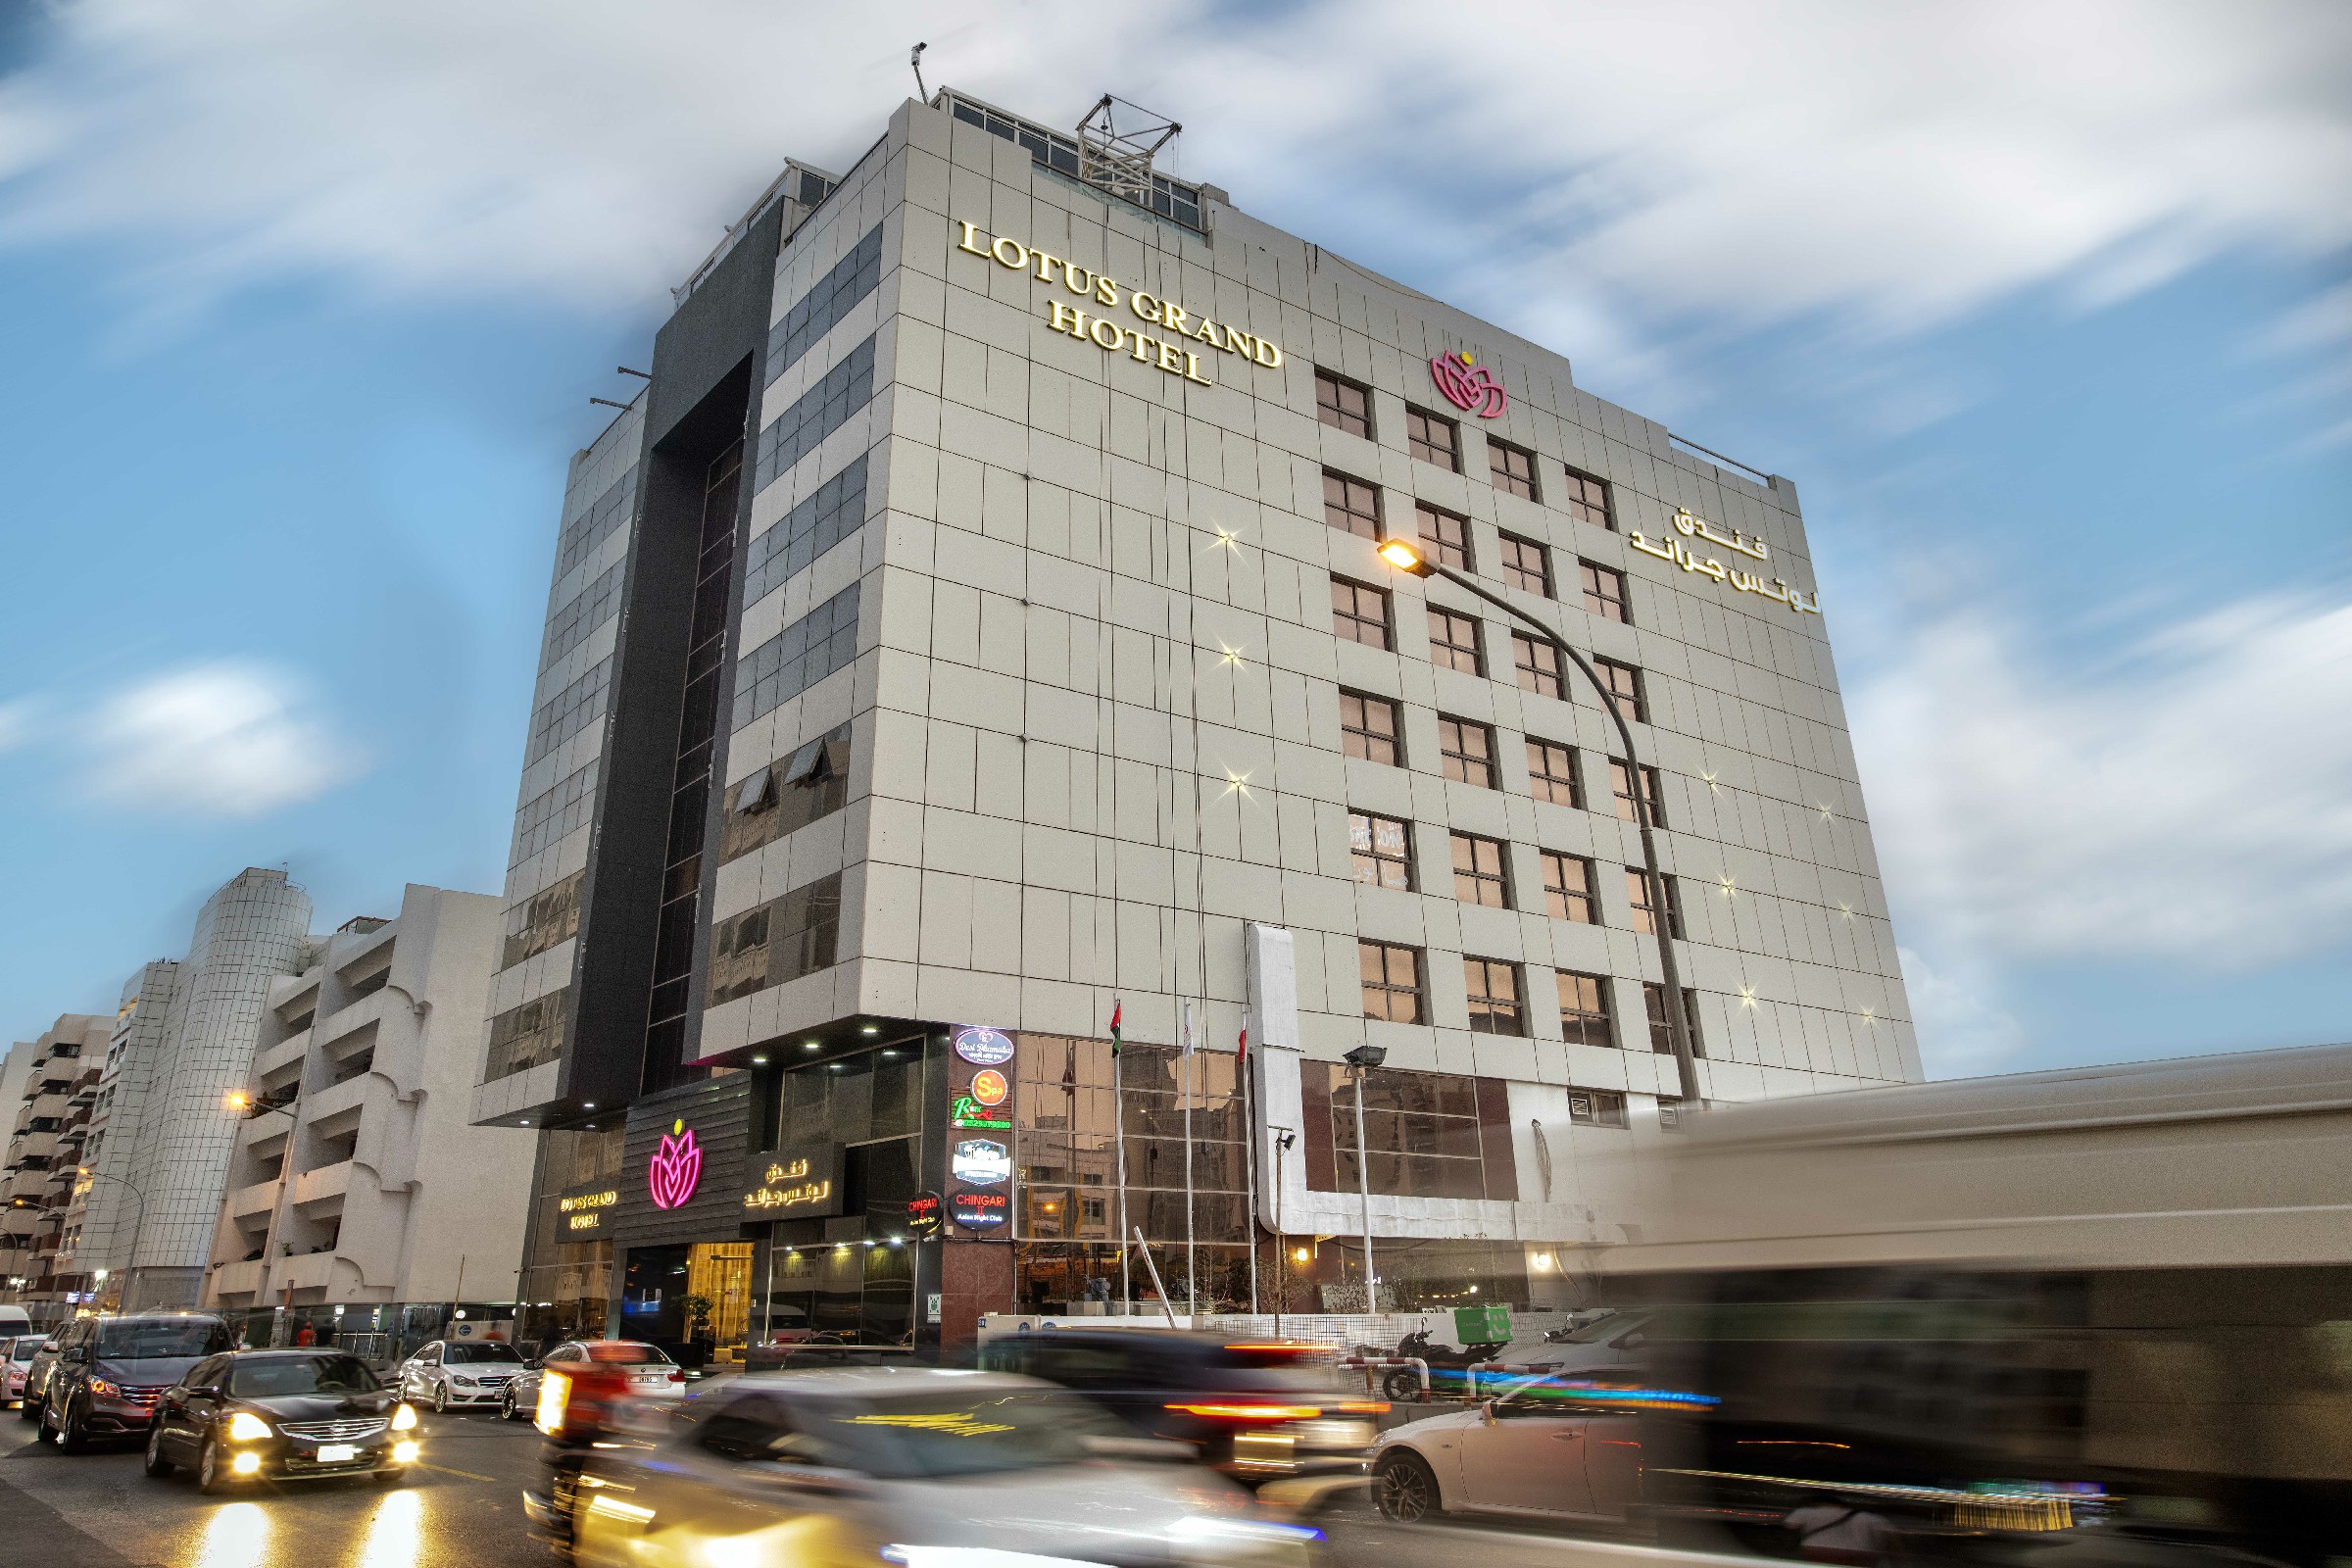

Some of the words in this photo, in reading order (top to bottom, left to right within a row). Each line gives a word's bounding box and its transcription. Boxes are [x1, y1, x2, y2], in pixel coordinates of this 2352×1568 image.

[957, 220, 1118, 307] LOTUS
[1130, 291, 1284, 368] GRAND
[1048, 299, 1212, 386] HOTEL
[1630, 530, 1726, 583] جراند
[1672, 507, 1768, 561] فندق
[1729, 568, 1822, 613] لوتس
[976, 1076, 1004, 1097] Spa
[908, 1198, 938, 1212] CHINGARI
[956, 1194, 1006, 1207] CHINGARI
